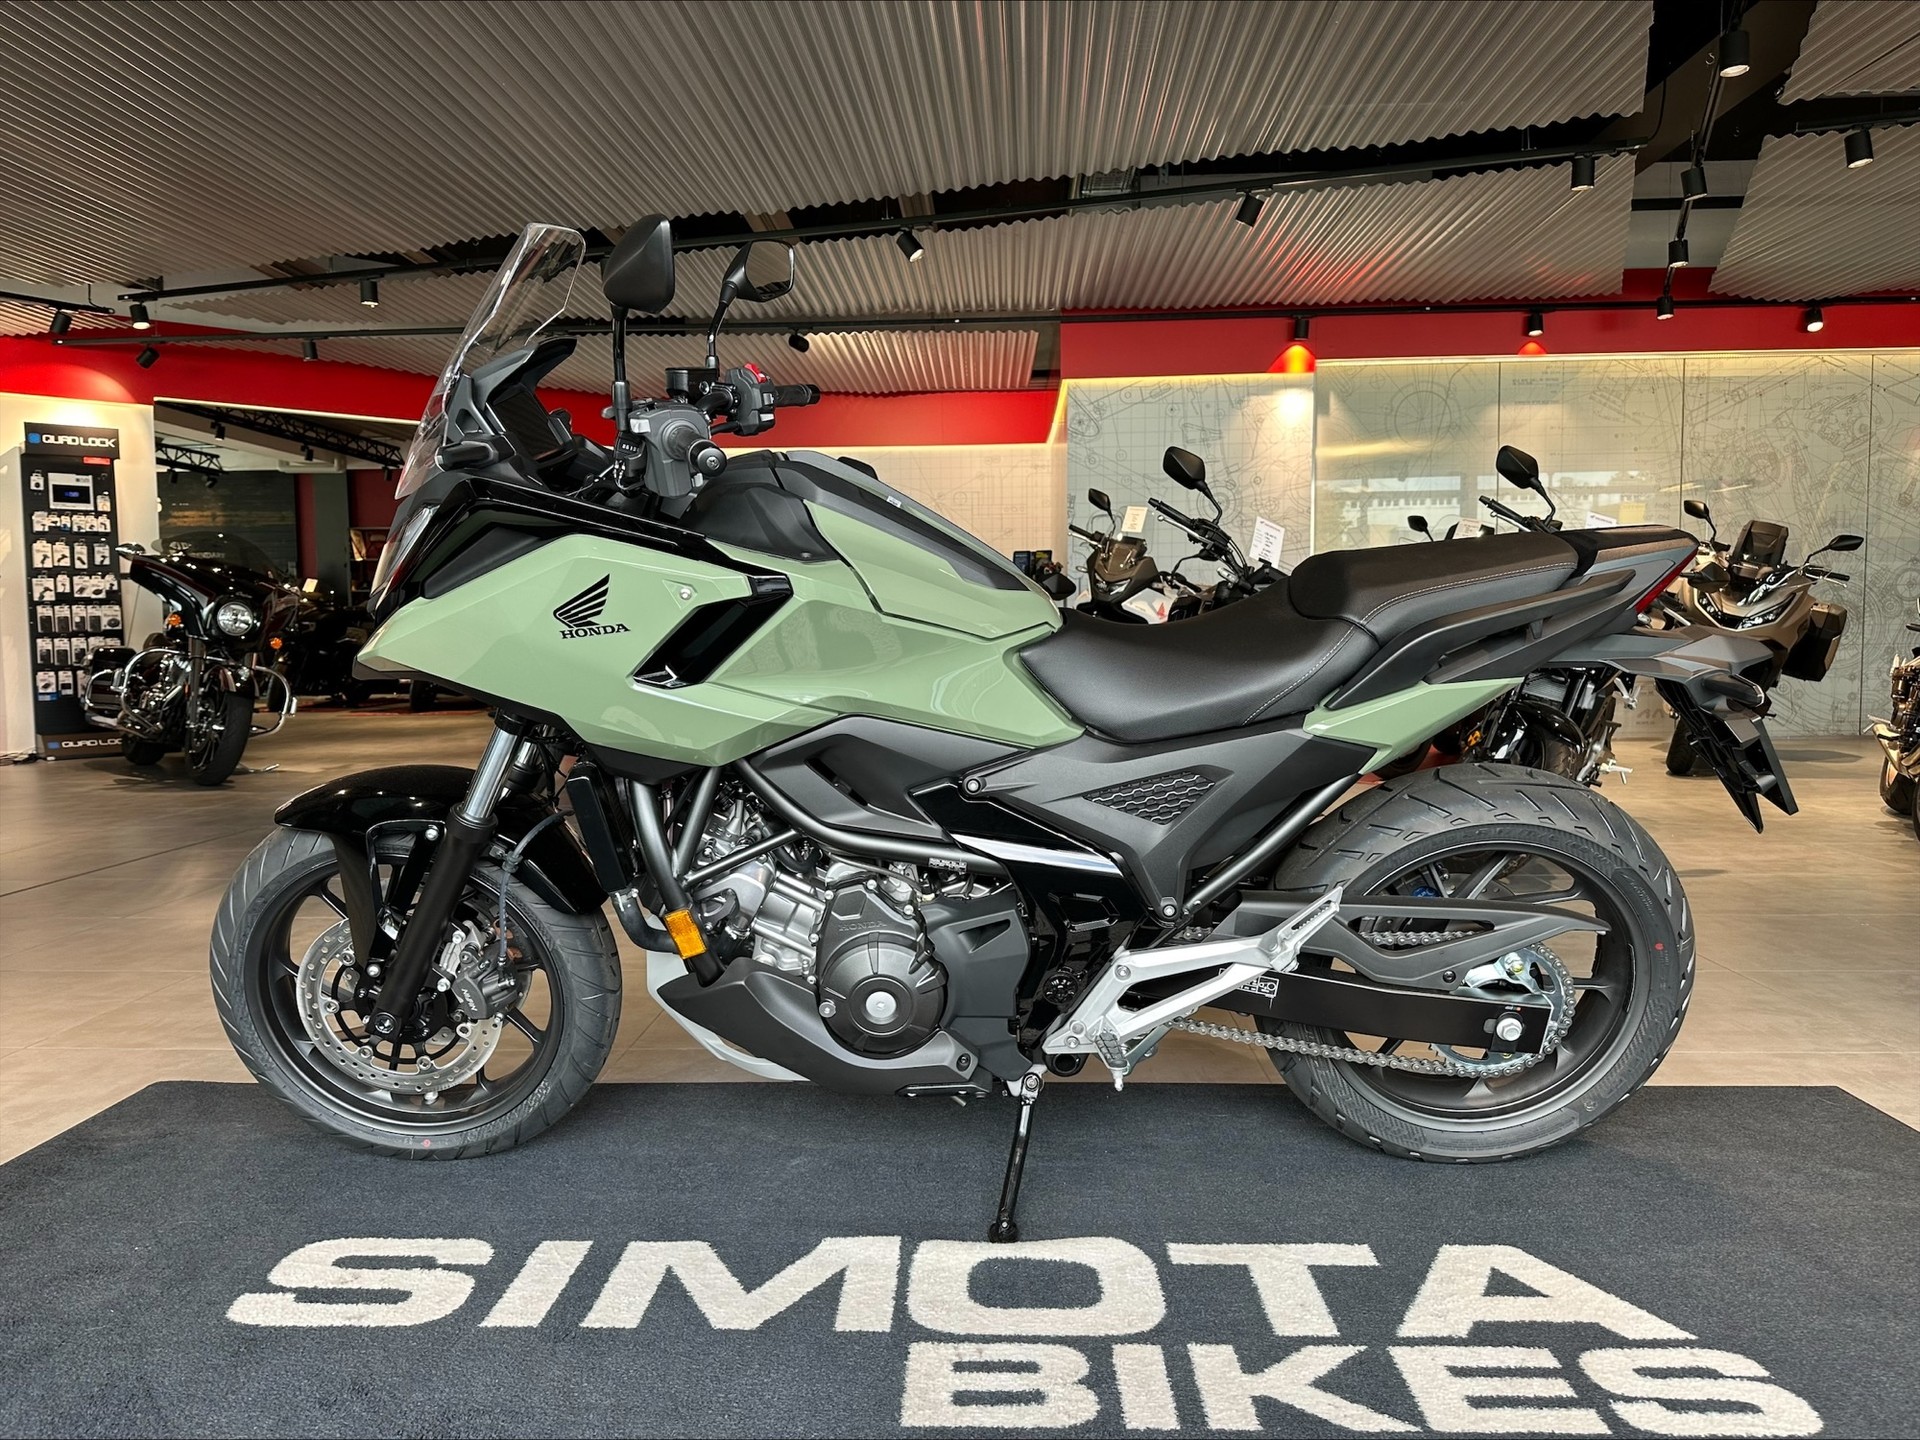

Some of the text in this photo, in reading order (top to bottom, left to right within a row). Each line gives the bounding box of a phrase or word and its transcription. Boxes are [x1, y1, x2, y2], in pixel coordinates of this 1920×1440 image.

[42, 434, 116, 448] QUAD LOCK
[559, 623, 631, 639] HONDA
[61, 738, 122, 748] QUAD LOC
[838, 920, 888, 931] HONDA
[226, 1235, 1699, 1342] SIMOTA
[900, 1341, 1825, 1438] BIKES
